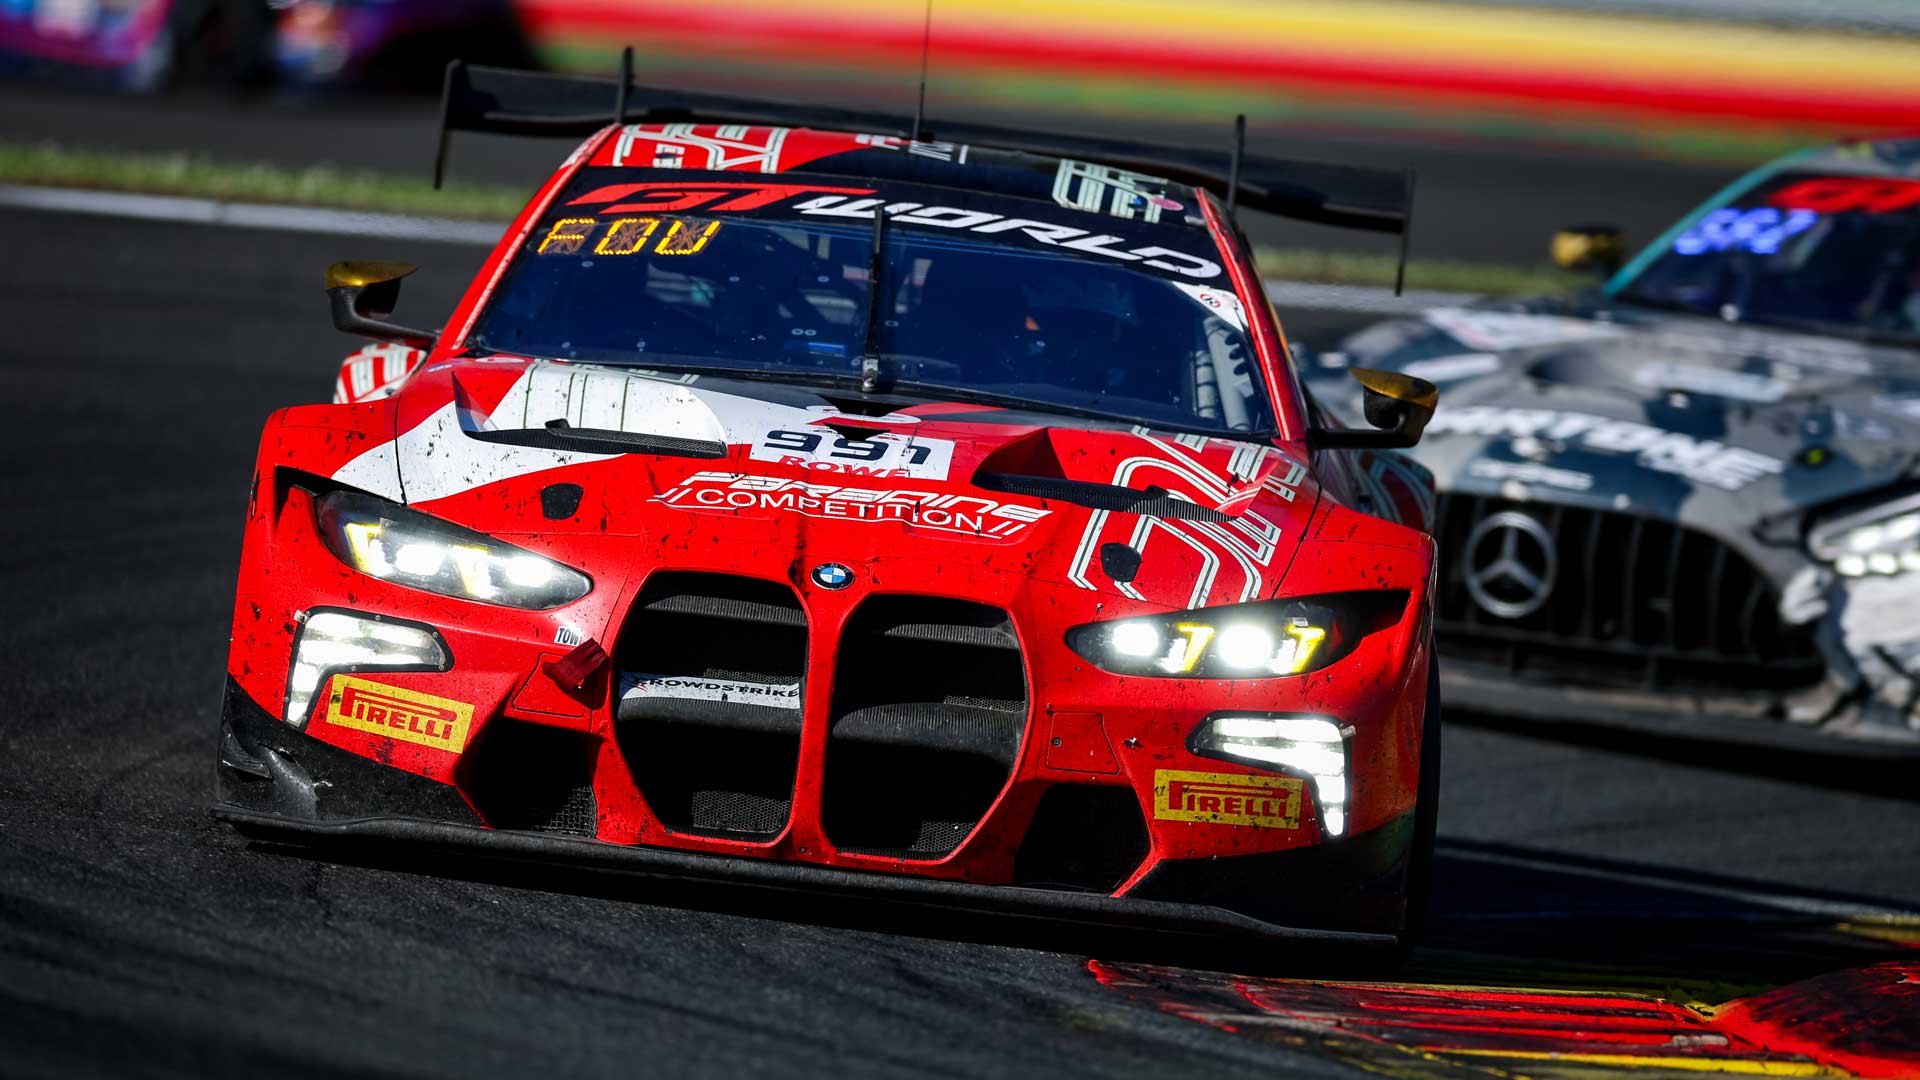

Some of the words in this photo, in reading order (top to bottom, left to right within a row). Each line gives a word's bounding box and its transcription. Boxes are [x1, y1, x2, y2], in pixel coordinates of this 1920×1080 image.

[566, 182, 878, 214] GT
[793, 195, 1222, 279] WORLD
[763, 429, 932, 465] 991
[695, 488, 984, 532] COMPETITION
[557, 627, 579, 646] TOW
[339, 686, 458, 741] PIRELLI
[1168, 780, 1291, 818] PIRELLI
